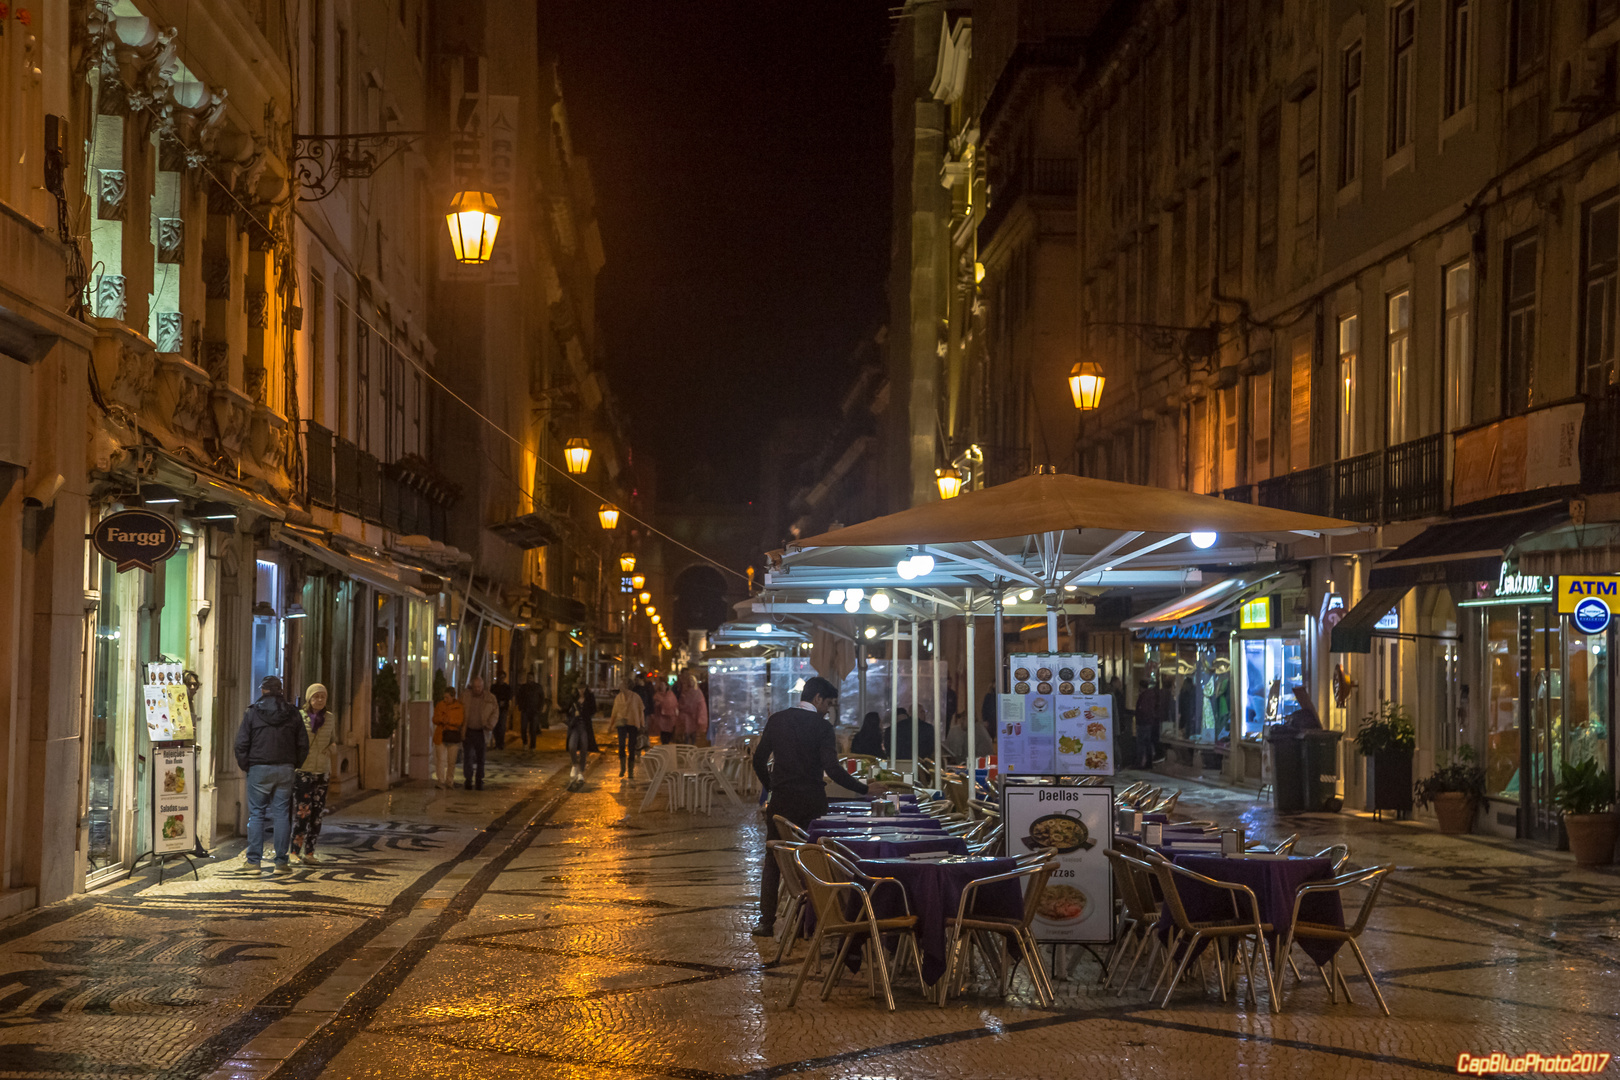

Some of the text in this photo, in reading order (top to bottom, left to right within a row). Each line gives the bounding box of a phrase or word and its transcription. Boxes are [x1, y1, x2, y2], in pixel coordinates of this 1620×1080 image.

[107, 527, 166, 547] Farggi
[1568, 580, 1617, 596] ATM
[1039, 789, 1079, 802] Paellas
